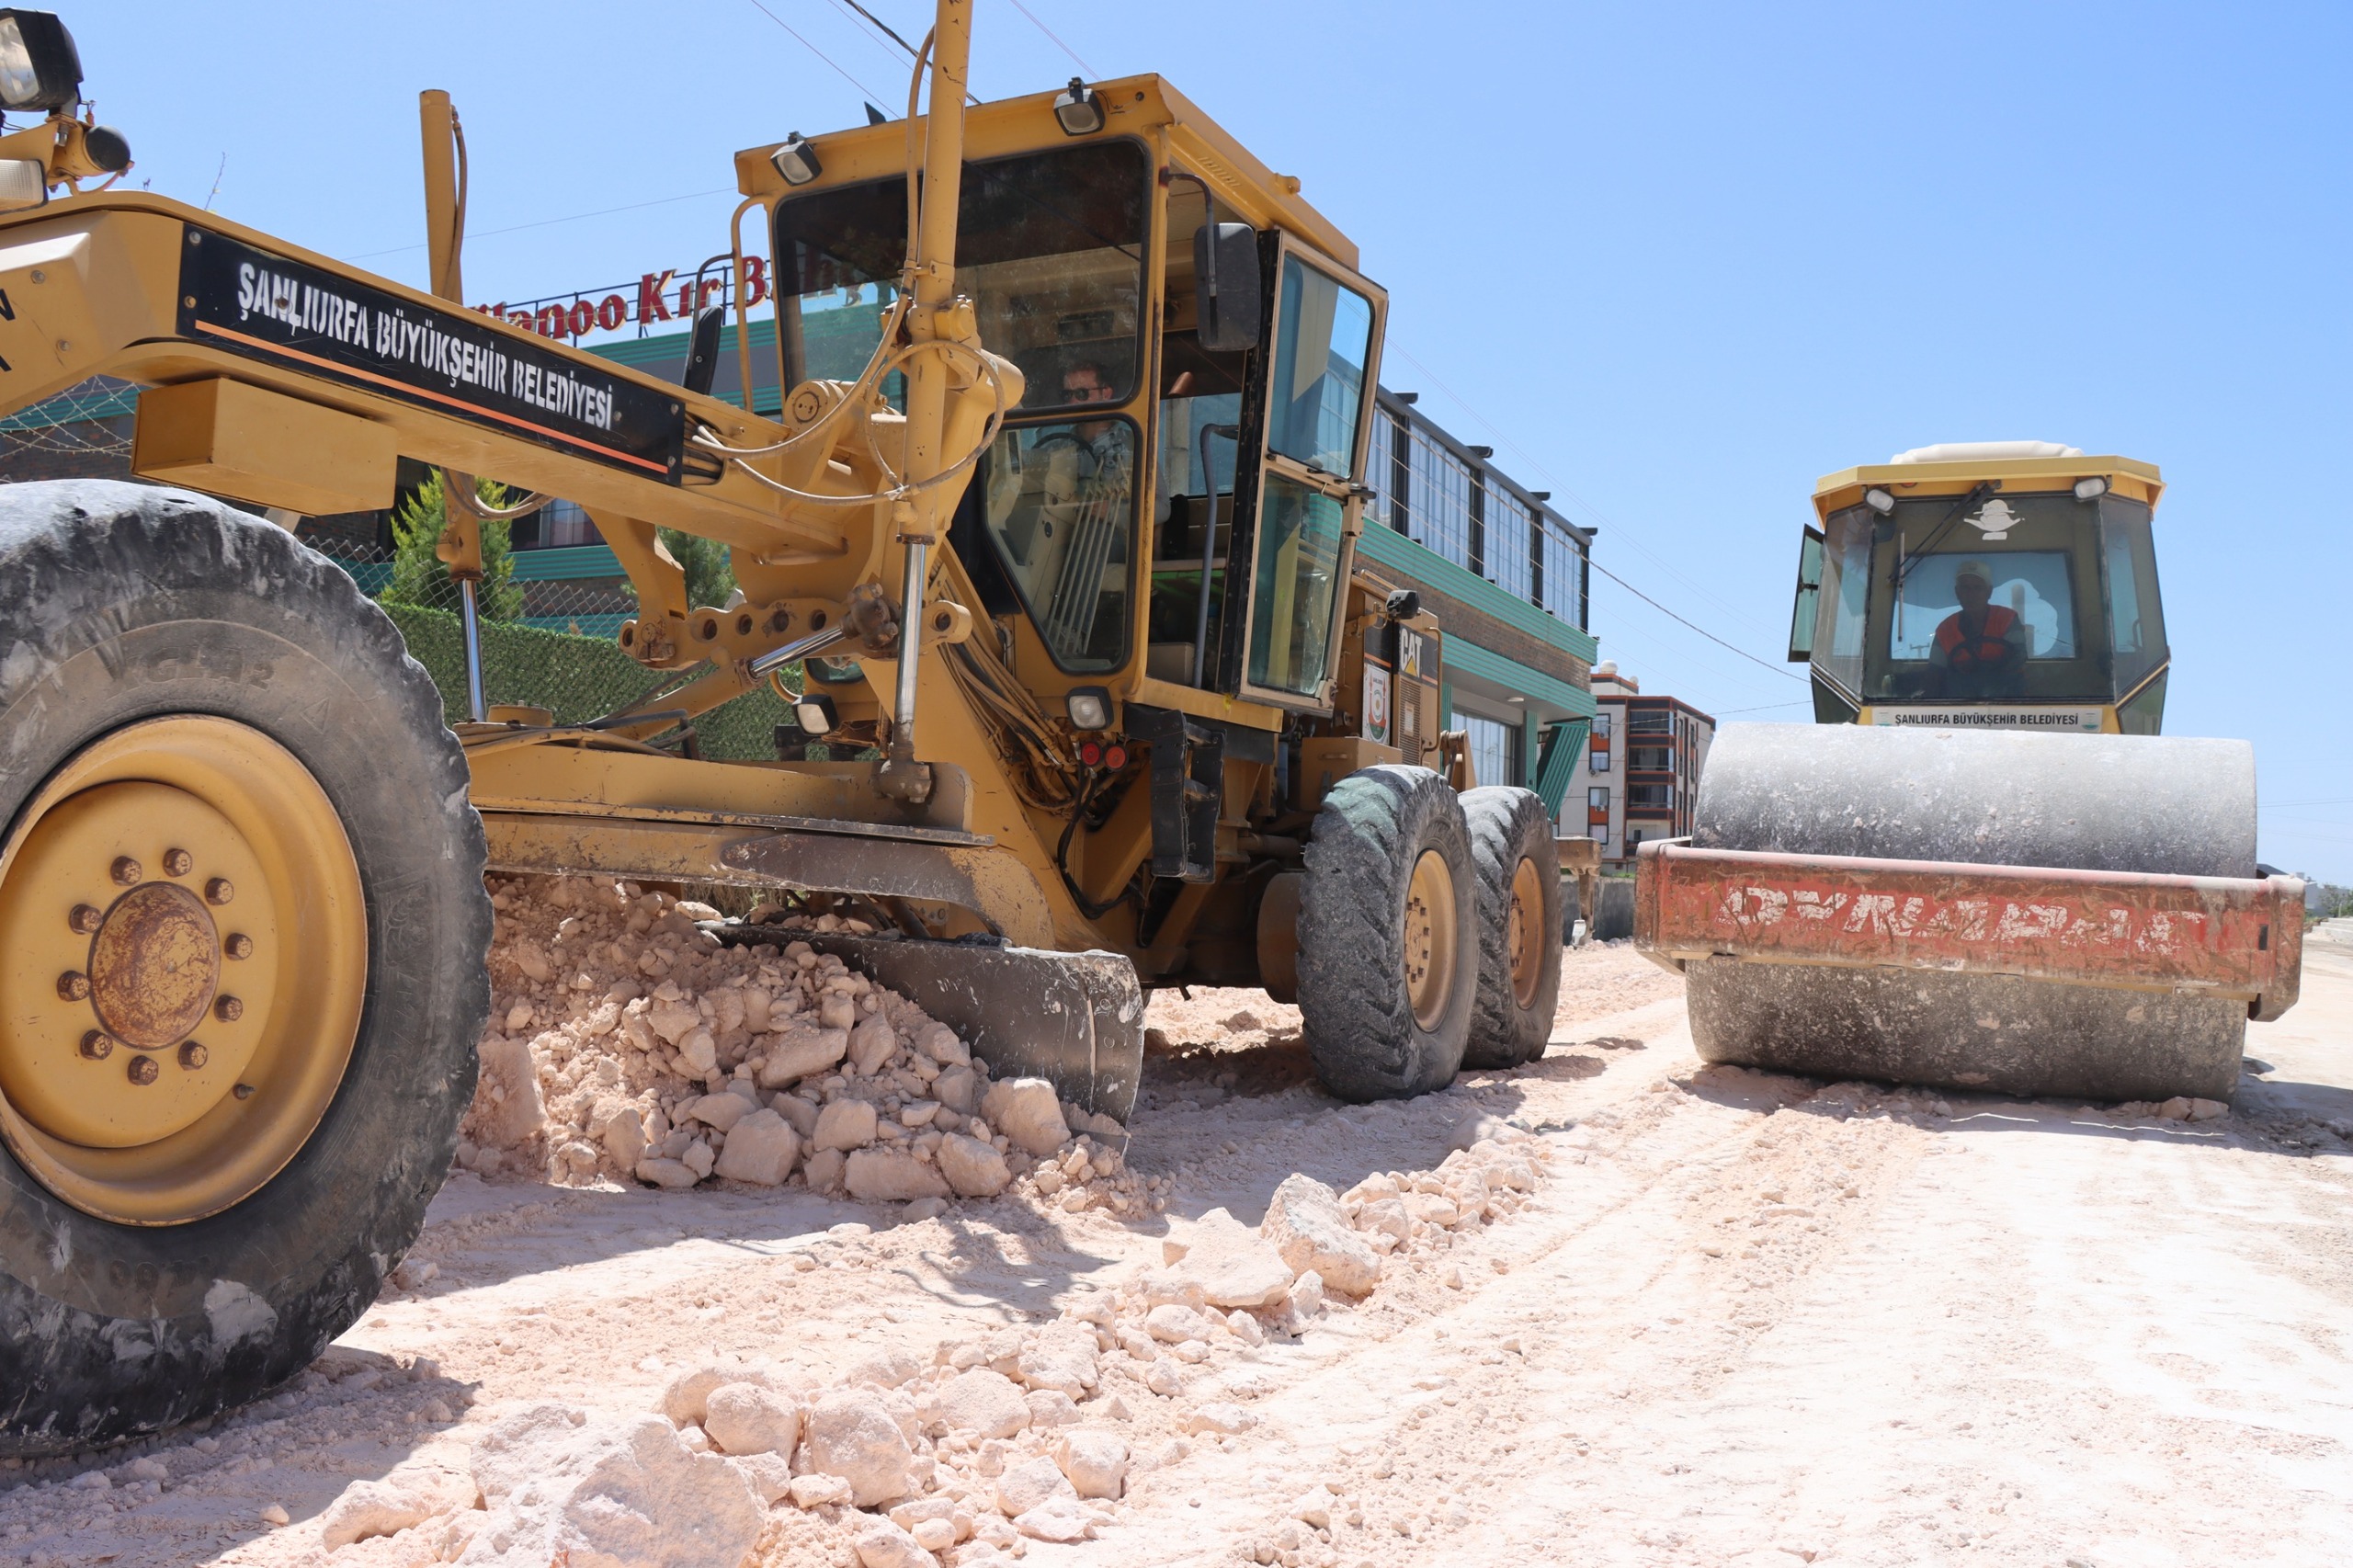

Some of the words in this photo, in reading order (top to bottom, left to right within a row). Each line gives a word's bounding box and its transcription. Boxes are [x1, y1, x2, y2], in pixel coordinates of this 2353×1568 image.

[238, 262, 369, 349] ŞANLIURFA
[376, 308, 507, 394] BÜYÜKŞEHİR
[512, 358, 613, 430] BELEDİYESİ
[1400, 629, 1423, 678] CAT
[1894, 713, 1949, 726] ŞANLIURFA
[1952, 711, 2017, 727] BÜYÜKŞEHİR
[2019, 712, 2078, 725] BELEDİYESİ
